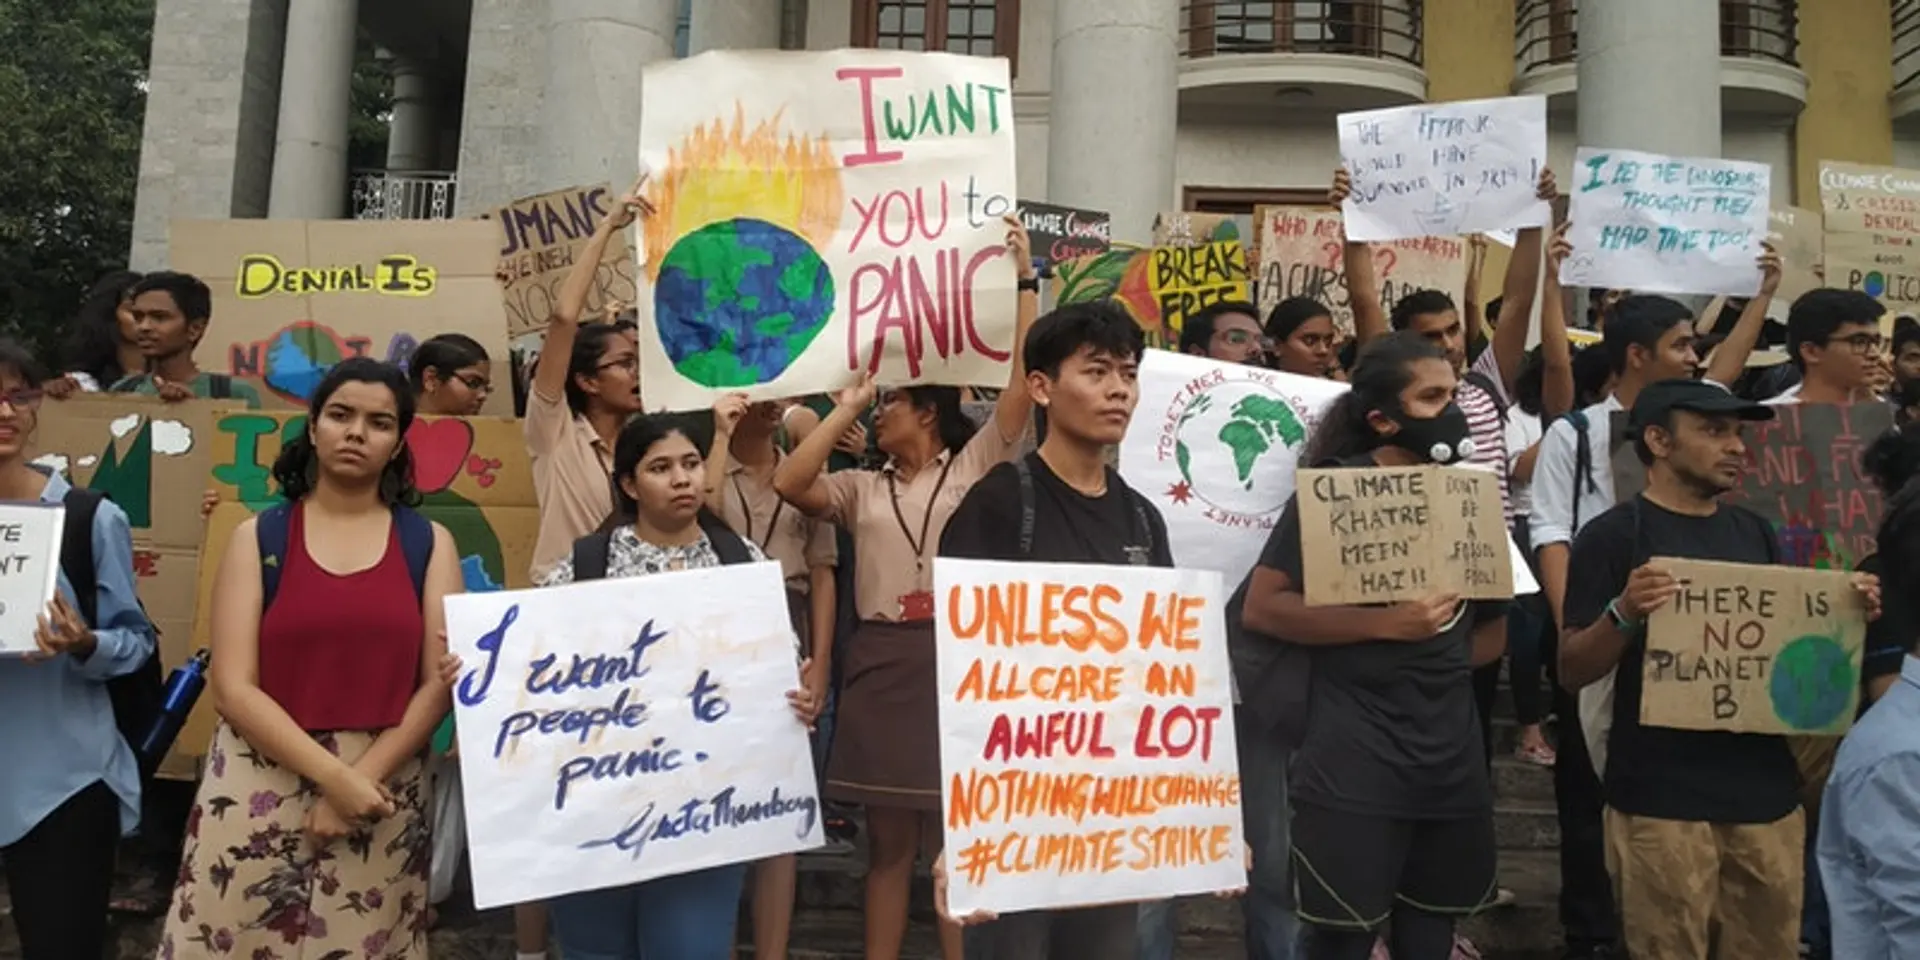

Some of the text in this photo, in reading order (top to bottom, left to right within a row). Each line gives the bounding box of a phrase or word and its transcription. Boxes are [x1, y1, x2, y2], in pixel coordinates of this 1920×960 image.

[836, 67, 1006, 167] I WANT
[1581, 154, 1608, 192] I
[848, 175, 1010, 254] YOU to
[1156, 243, 1250, 289] BREAK
[1288, 262, 1350, 307] CURS
[847, 245, 1011, 379] PANIC
[1160, 286, 1237, 336] FR
[1313, 472, 1425, 503] CLIMATE
[1330, 504, 1430, 536] KHATRE
[949, 581, 1206, 654] UNLESS WE
[1673, 578, 1830, 618] THERE IS
[525, 619, 668, 695] want
[1703, 619, 1766, 654] NO
[1144, 661, 1196, 698] AN
[1651, 649, 1771, 683] PLANET
[493, 669, 731, 758] people to
[1712, 684, 1739, 720] B
[983, 704, 1223, 764] AWFUL LOT
[949, 768, 1243, 831] NOTHING WILL CHANGE
